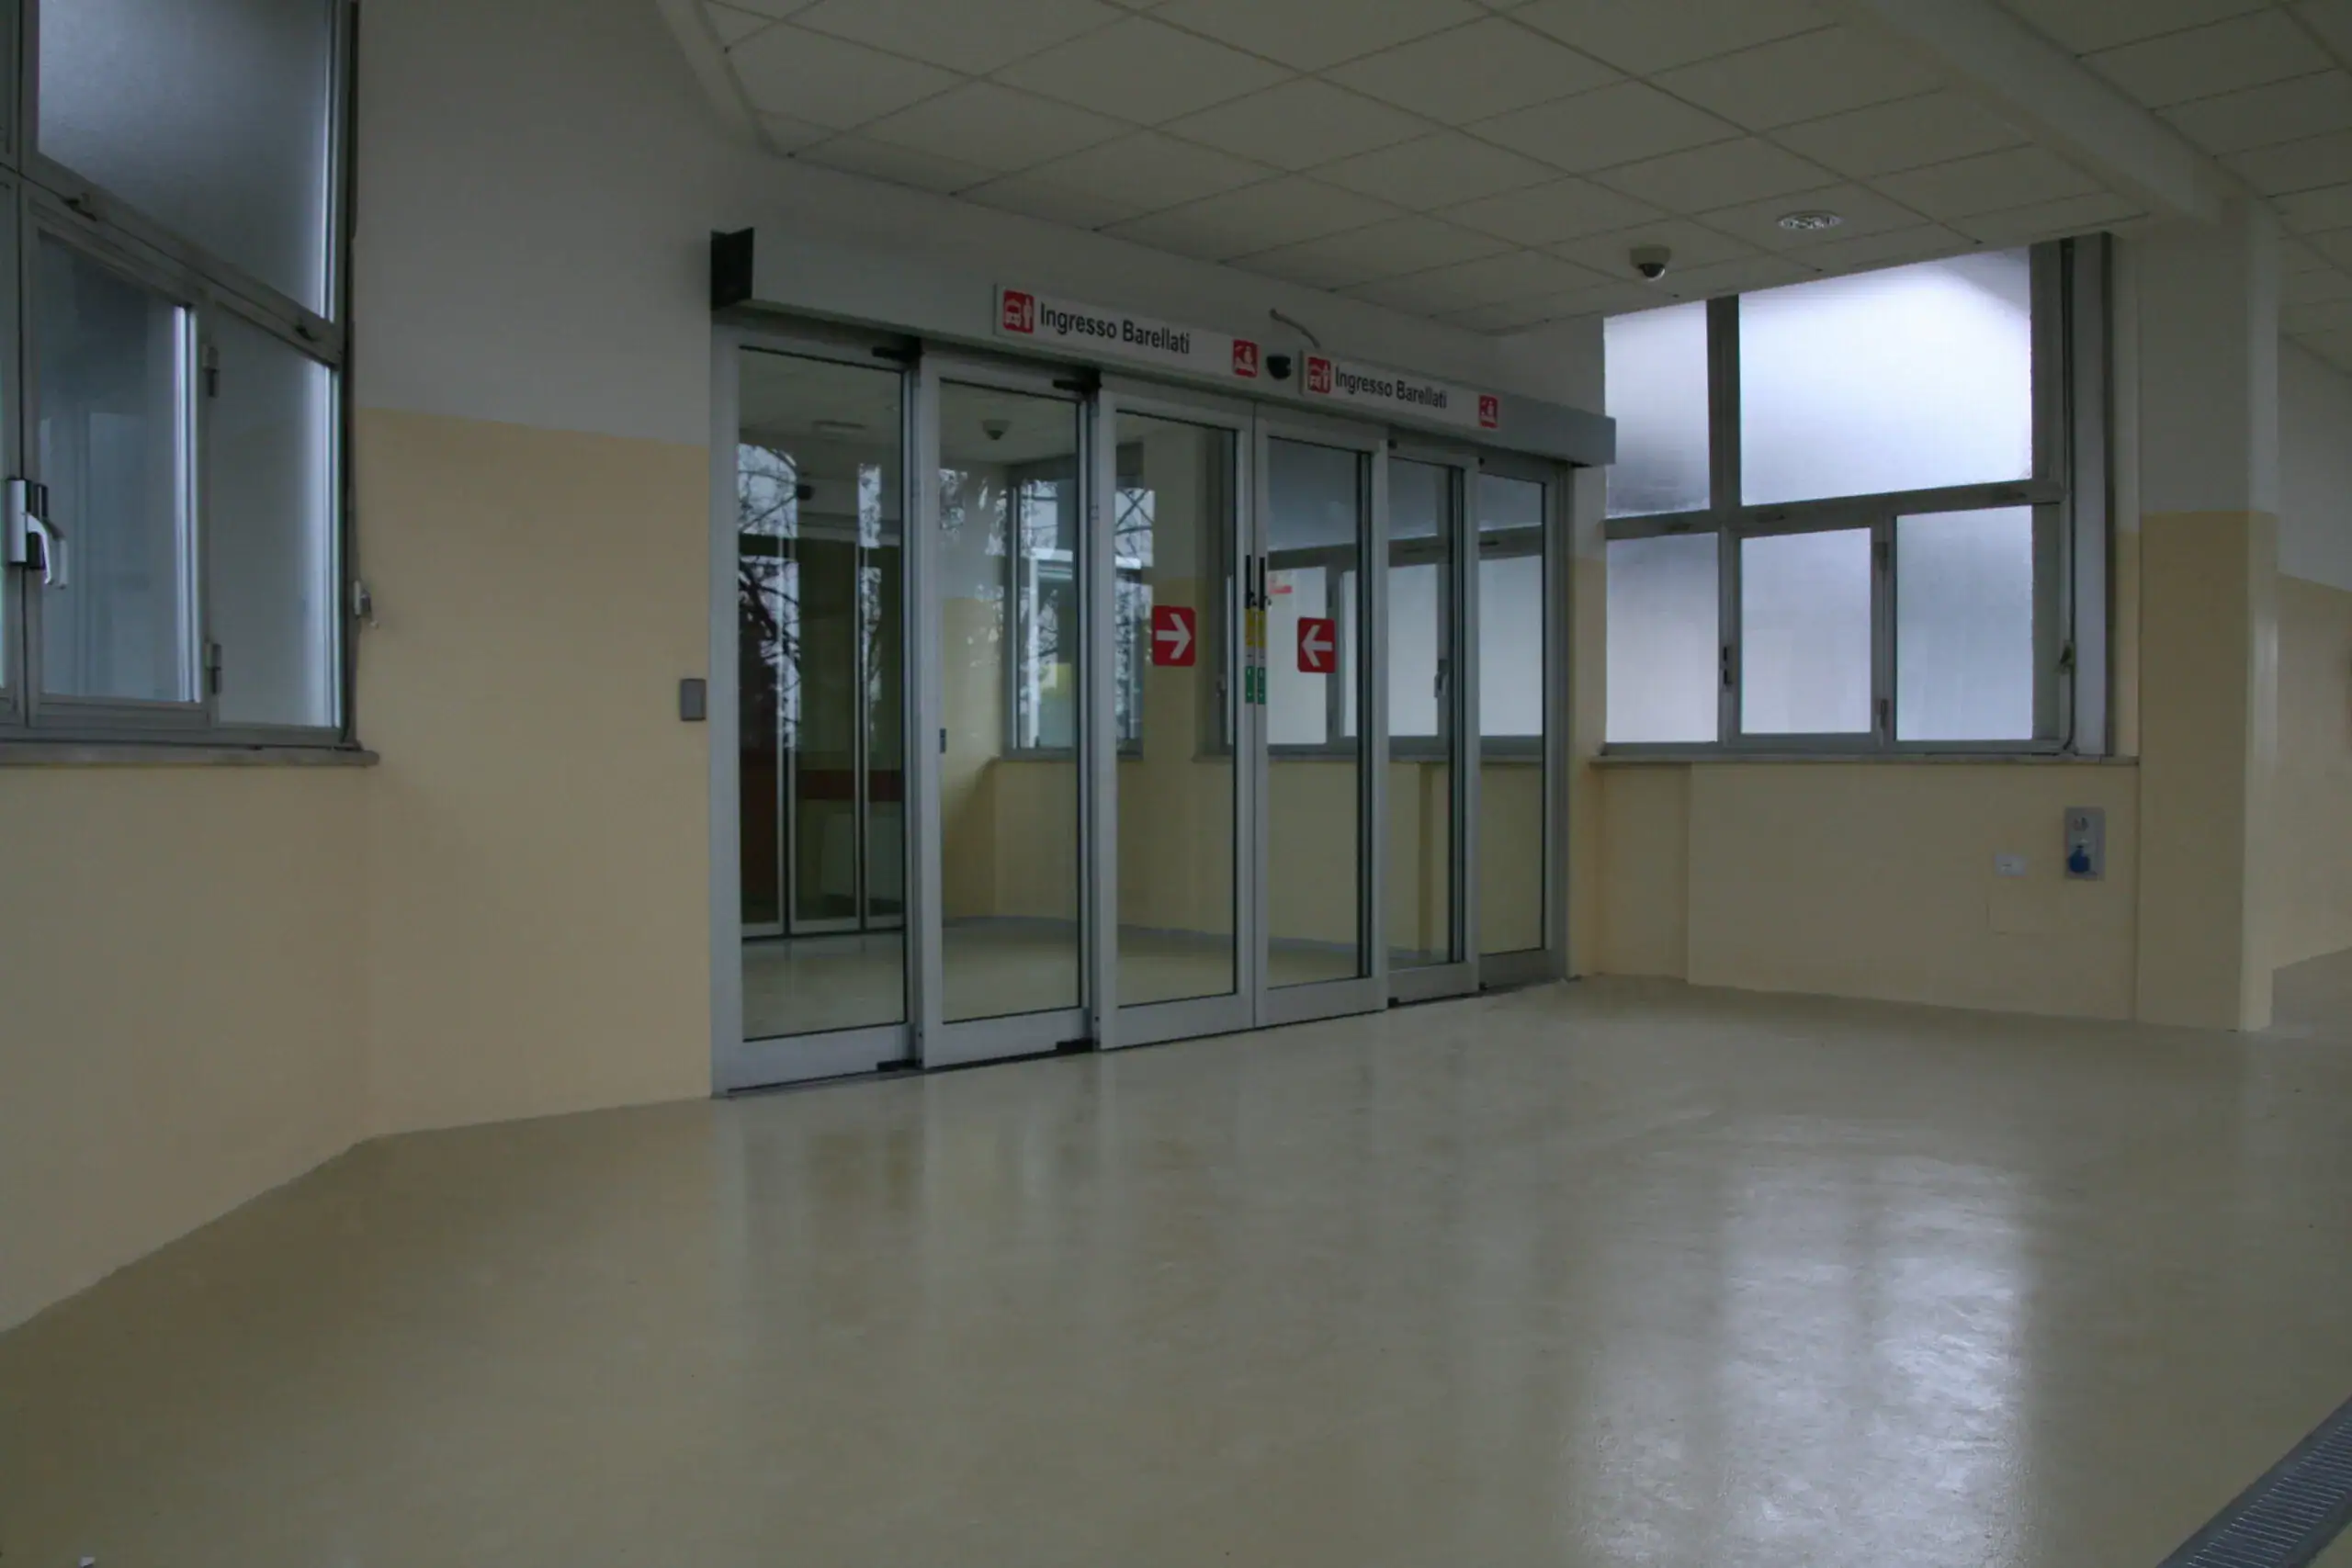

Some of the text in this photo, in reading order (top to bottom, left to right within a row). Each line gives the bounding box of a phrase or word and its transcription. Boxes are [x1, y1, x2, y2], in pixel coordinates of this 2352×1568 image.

[1040, 302, 1191, 355] Ingresso Barellati
[1335, 366, 1447, 409] Ingresso Barellati
